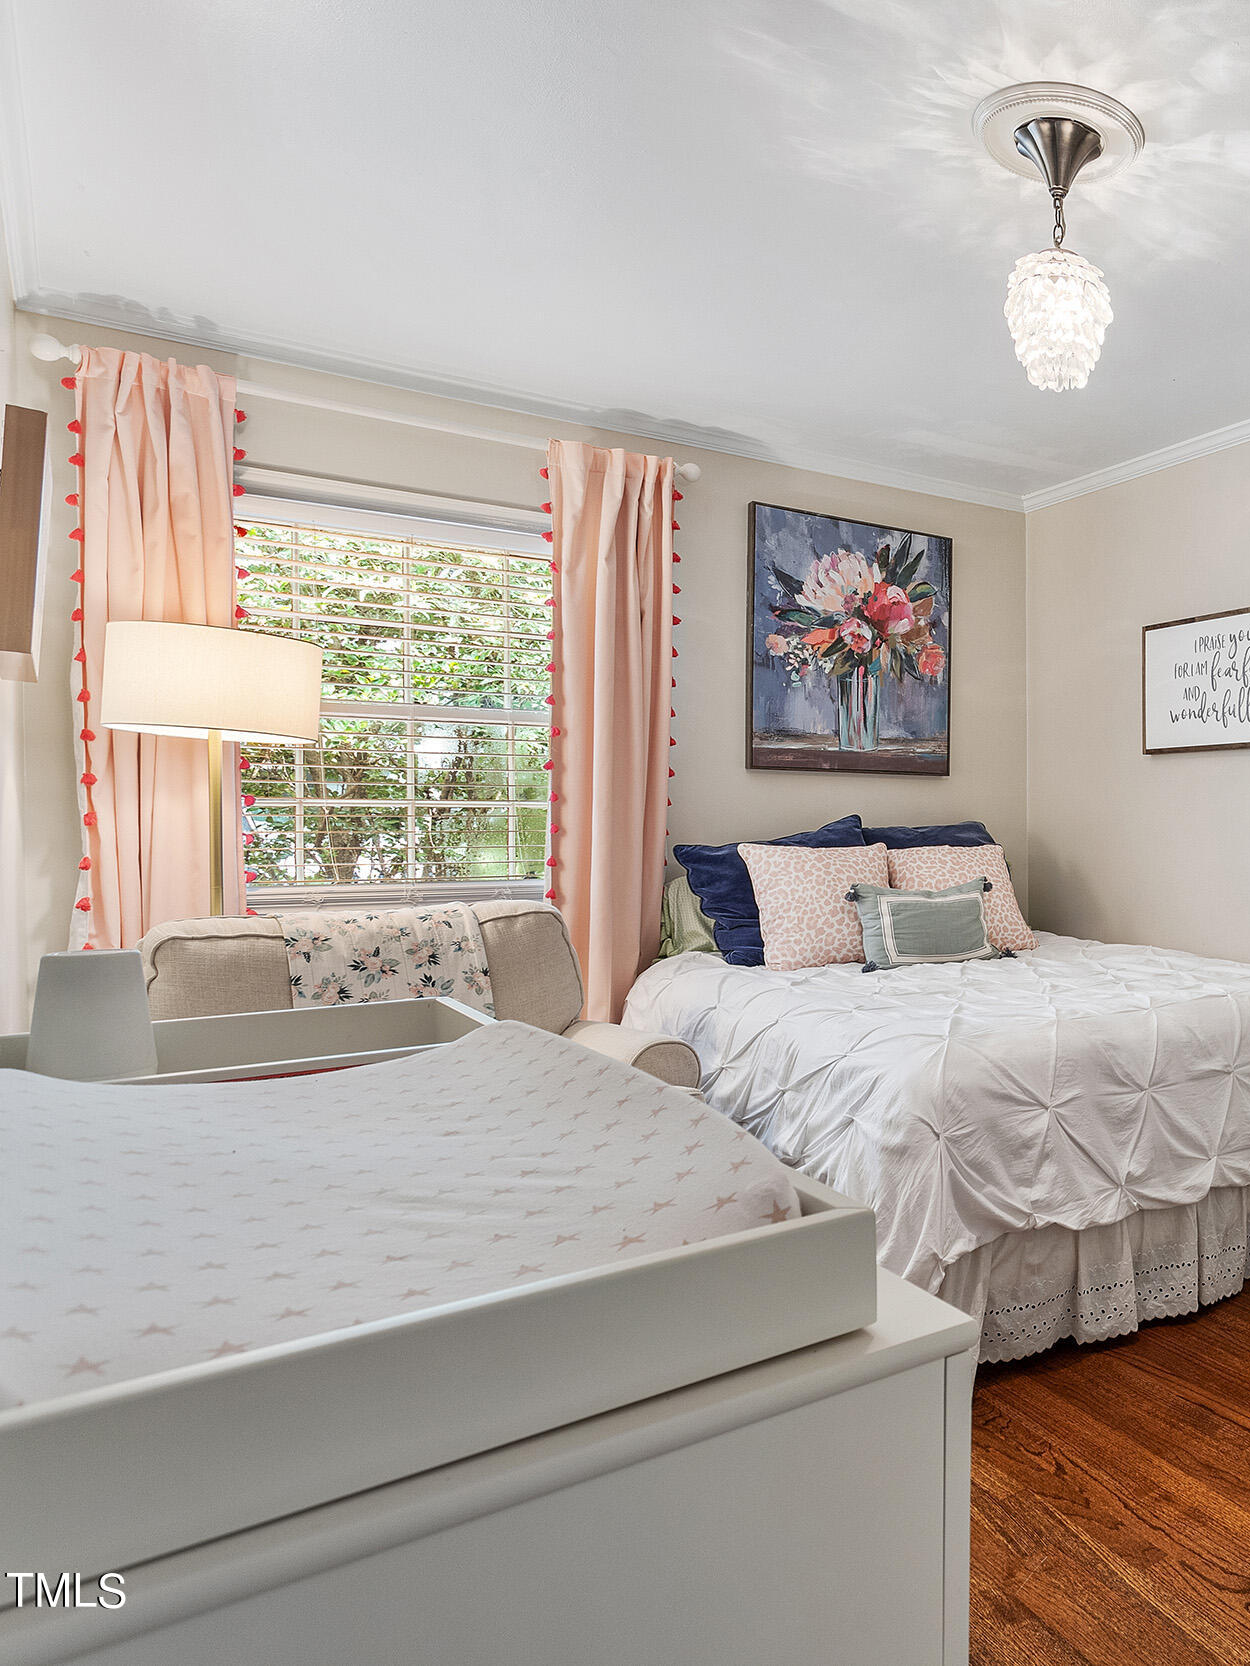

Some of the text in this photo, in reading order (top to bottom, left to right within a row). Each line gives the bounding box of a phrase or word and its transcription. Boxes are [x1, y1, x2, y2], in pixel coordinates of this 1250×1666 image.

[1174, 662, 1190, 679] FOR
[1195, 660, 1208, 676] AM
[1182, 685, 1201, 702] AND
